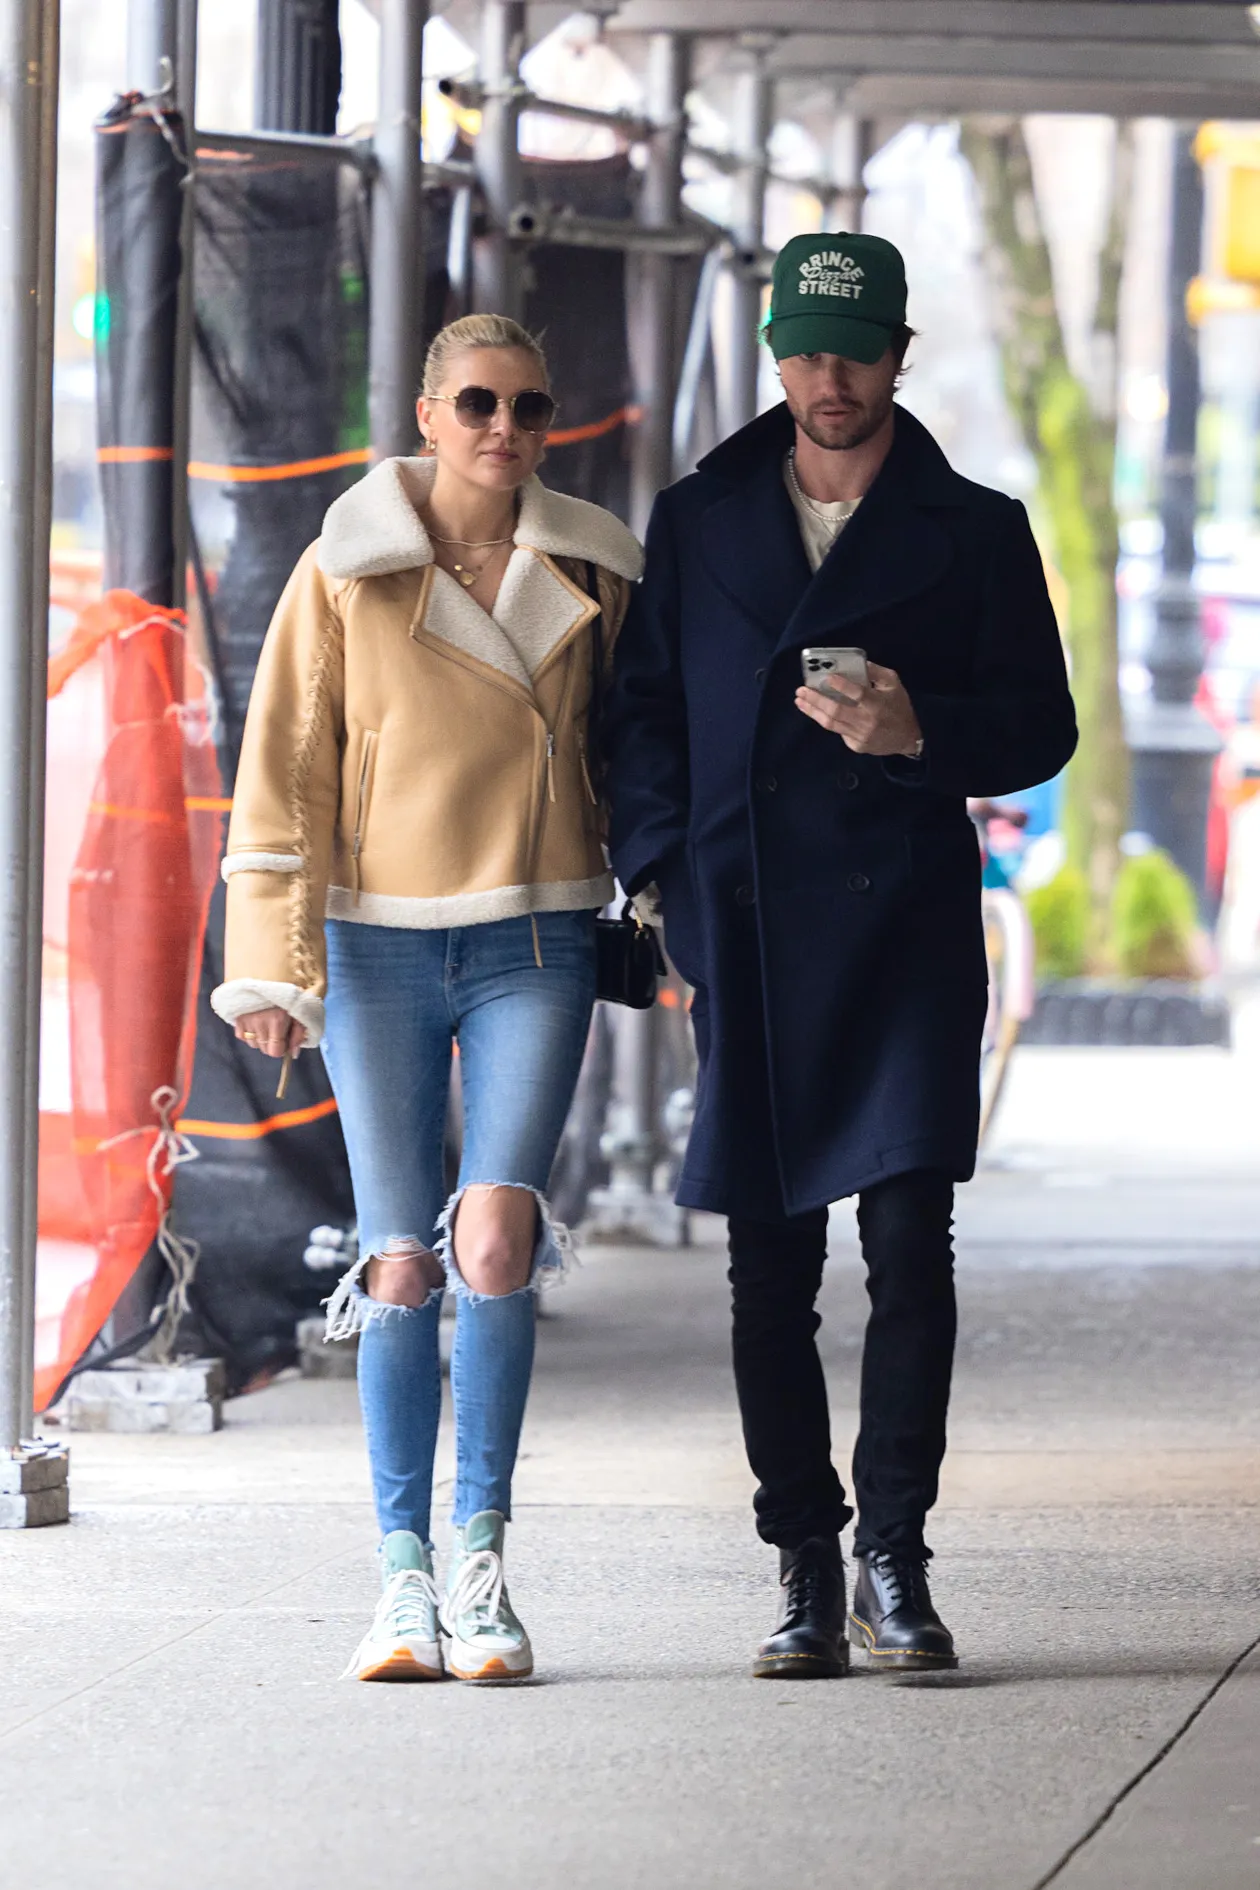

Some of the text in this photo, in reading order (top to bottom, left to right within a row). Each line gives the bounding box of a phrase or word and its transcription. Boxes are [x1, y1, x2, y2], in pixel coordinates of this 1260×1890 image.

[799, 250, 865, 282] PRINCE
[807, 266, 852, 285] Pizza
[798, 280, 863, 299] STREET
